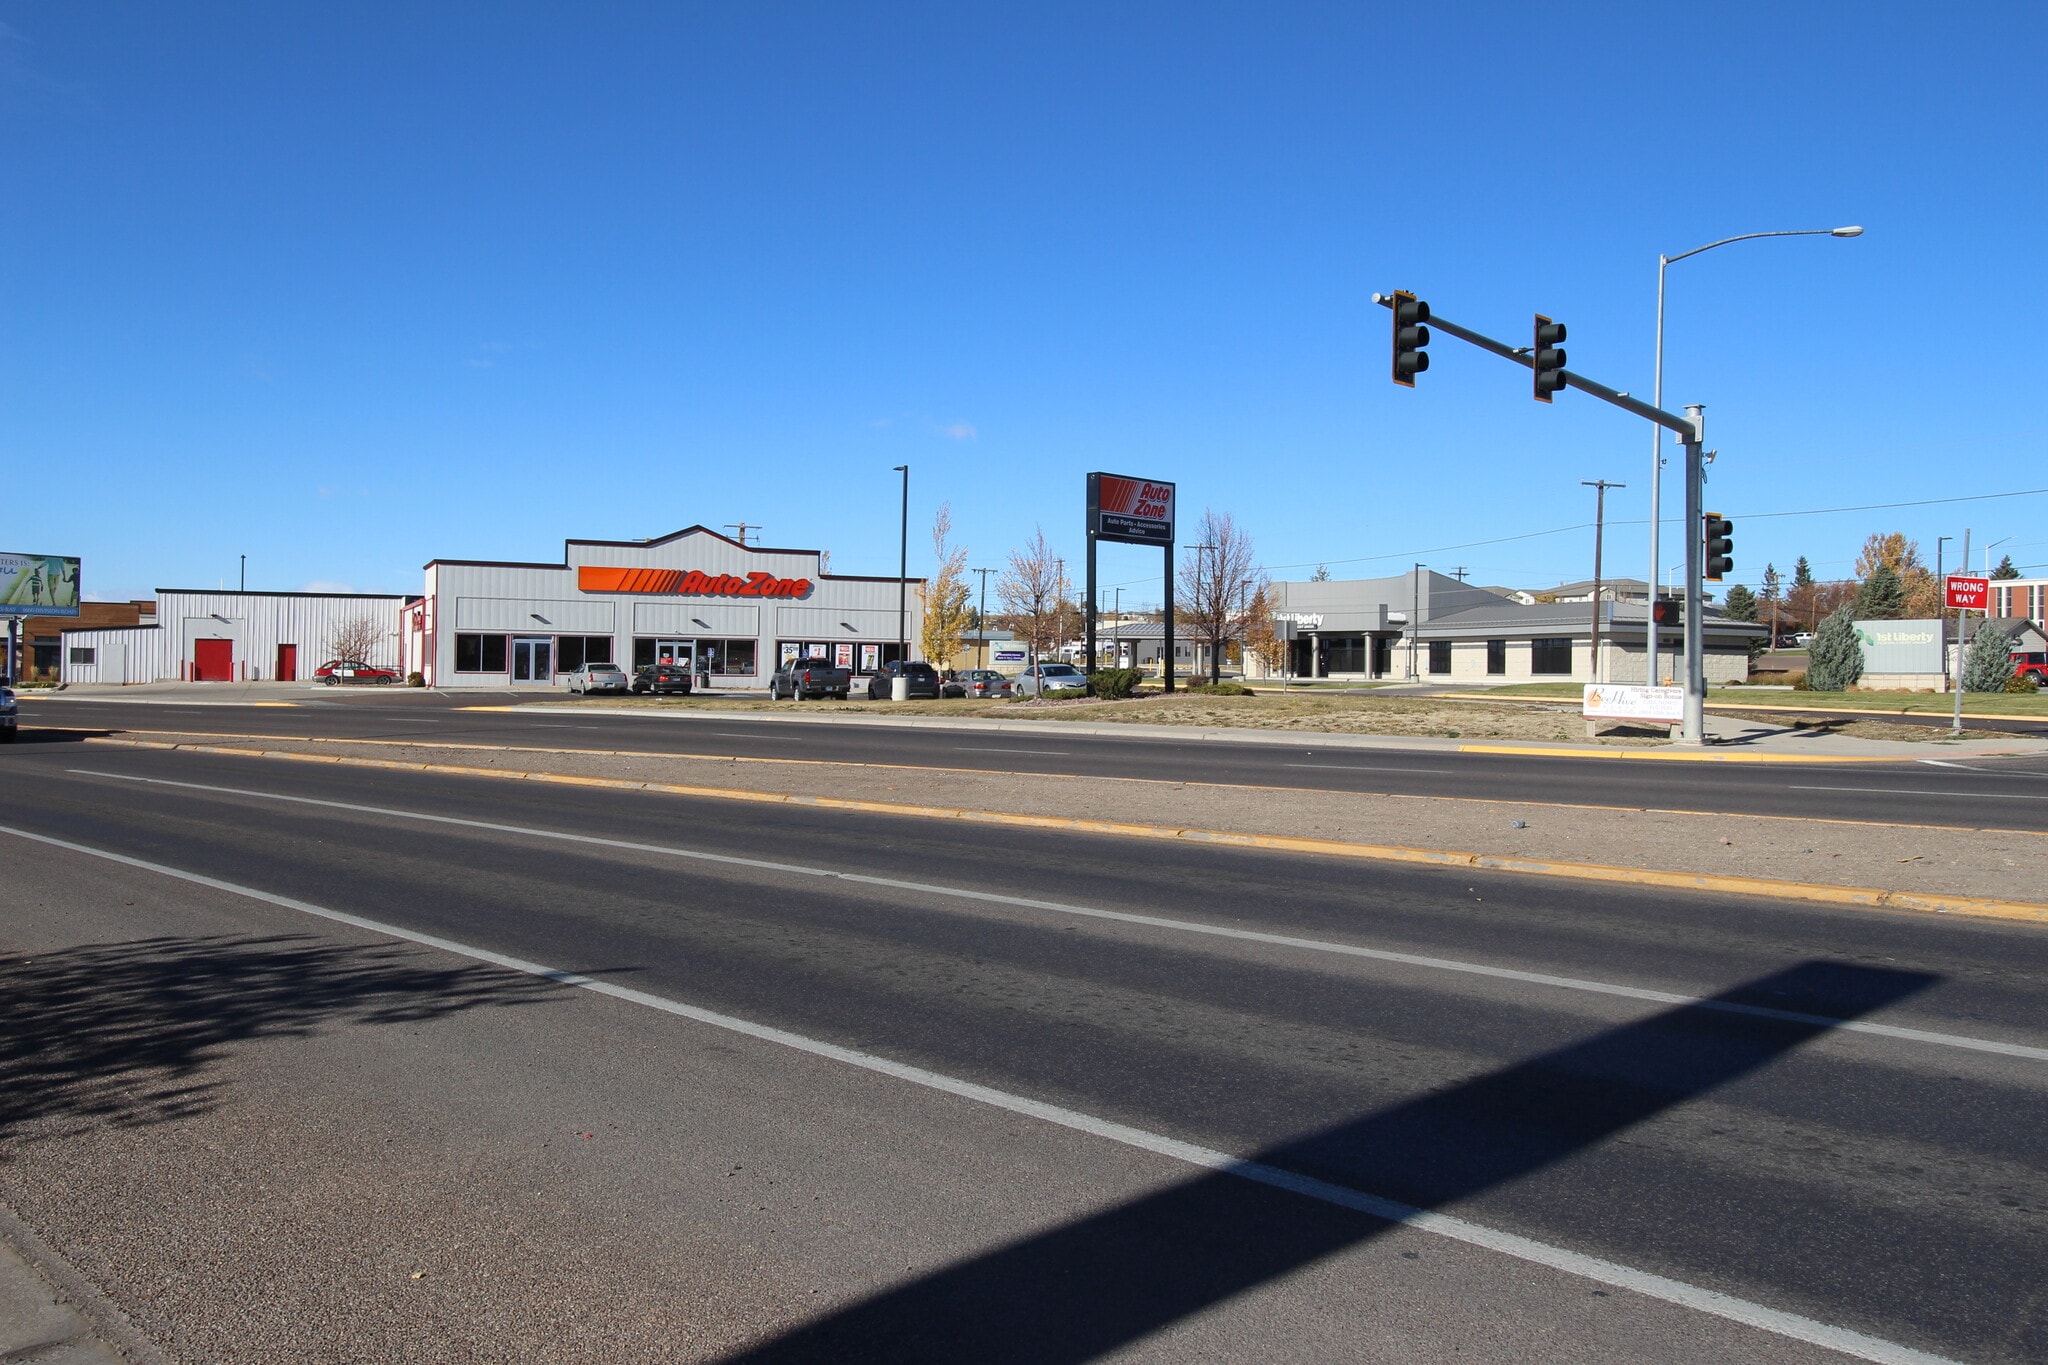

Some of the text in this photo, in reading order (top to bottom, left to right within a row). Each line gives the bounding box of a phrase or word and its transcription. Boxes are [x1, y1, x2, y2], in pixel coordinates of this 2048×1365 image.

[1139, 482, 1172, 502] Auto
[1133, 498, 1167, 519] Zone
[1107, 517, 1166, 530] Auto Parts Accessories
[1128, 527, 1146, 535] Advice
[677, 569, 811, 598] AutoZone
[1950, 581, 1984, 593] WRONG
[1955, 594, 1976, 604] WAY
[1876, 631, 1934, 643] 1st Liberty
[1588, 687, 1637, 706] BeeHive
